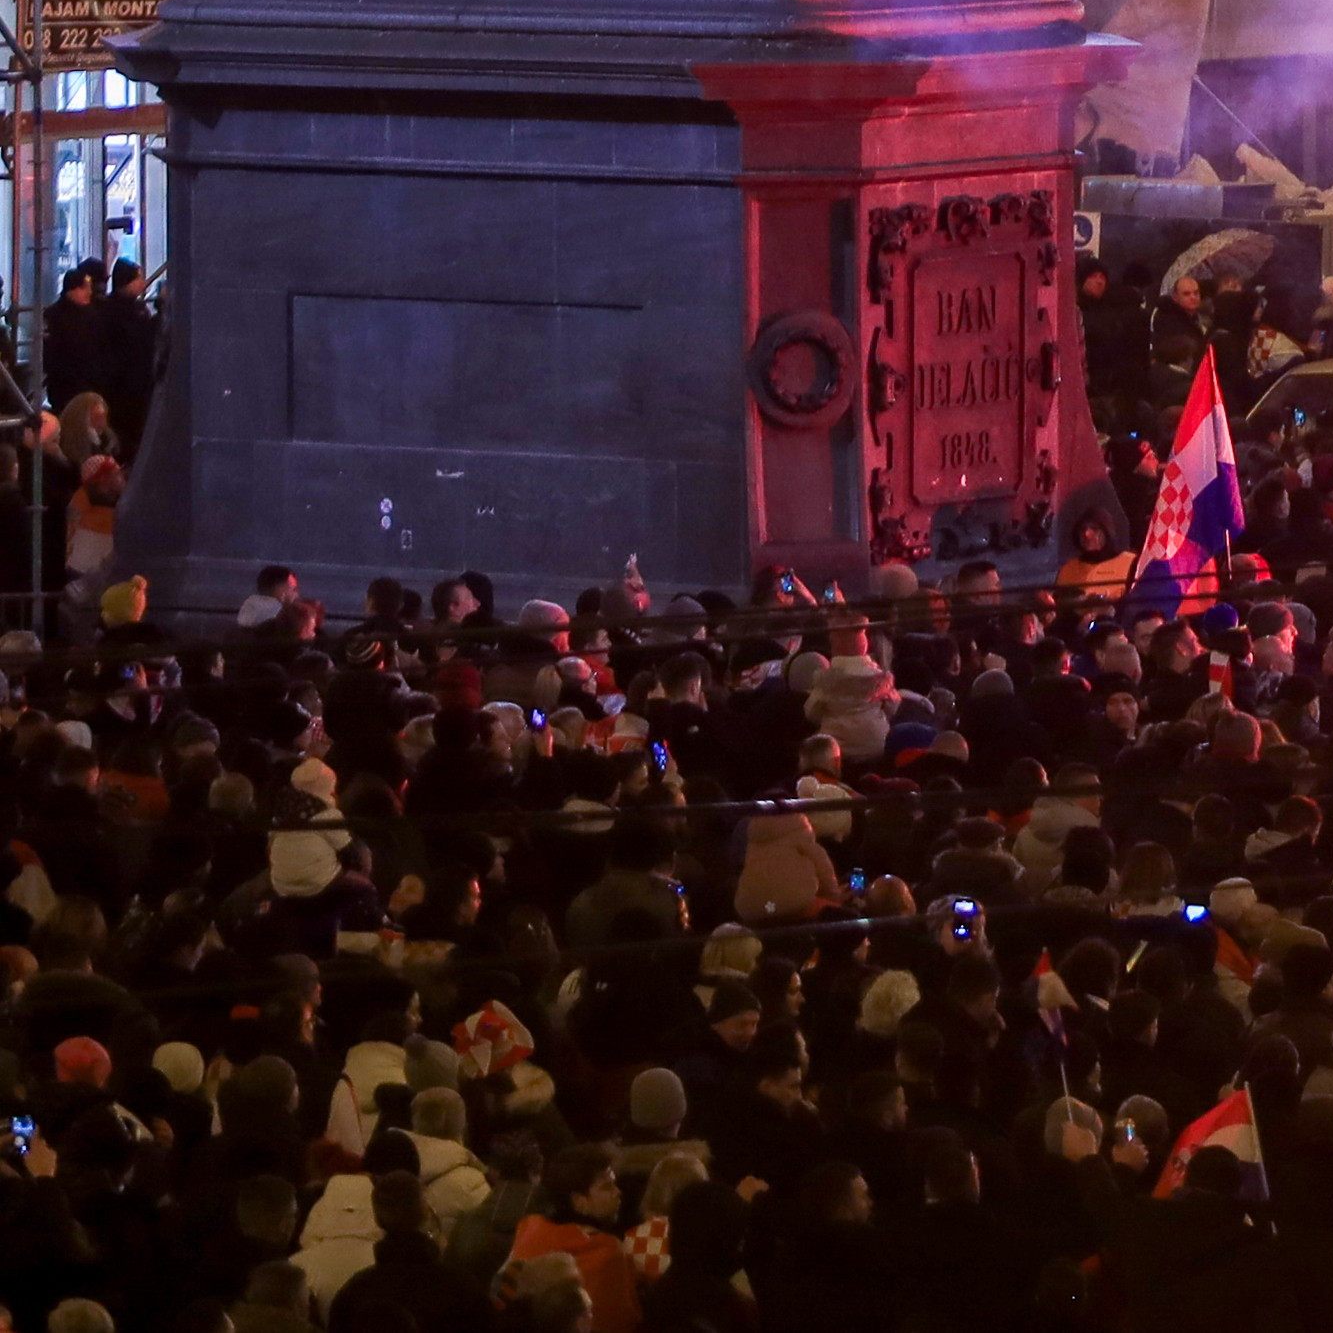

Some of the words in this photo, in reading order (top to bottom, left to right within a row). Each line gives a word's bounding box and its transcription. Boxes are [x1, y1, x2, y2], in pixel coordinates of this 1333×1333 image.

[30, 0, 90, 16] AJAM
[24, 29, 50, 49] 08
[61, 29, 87, 48] 222
